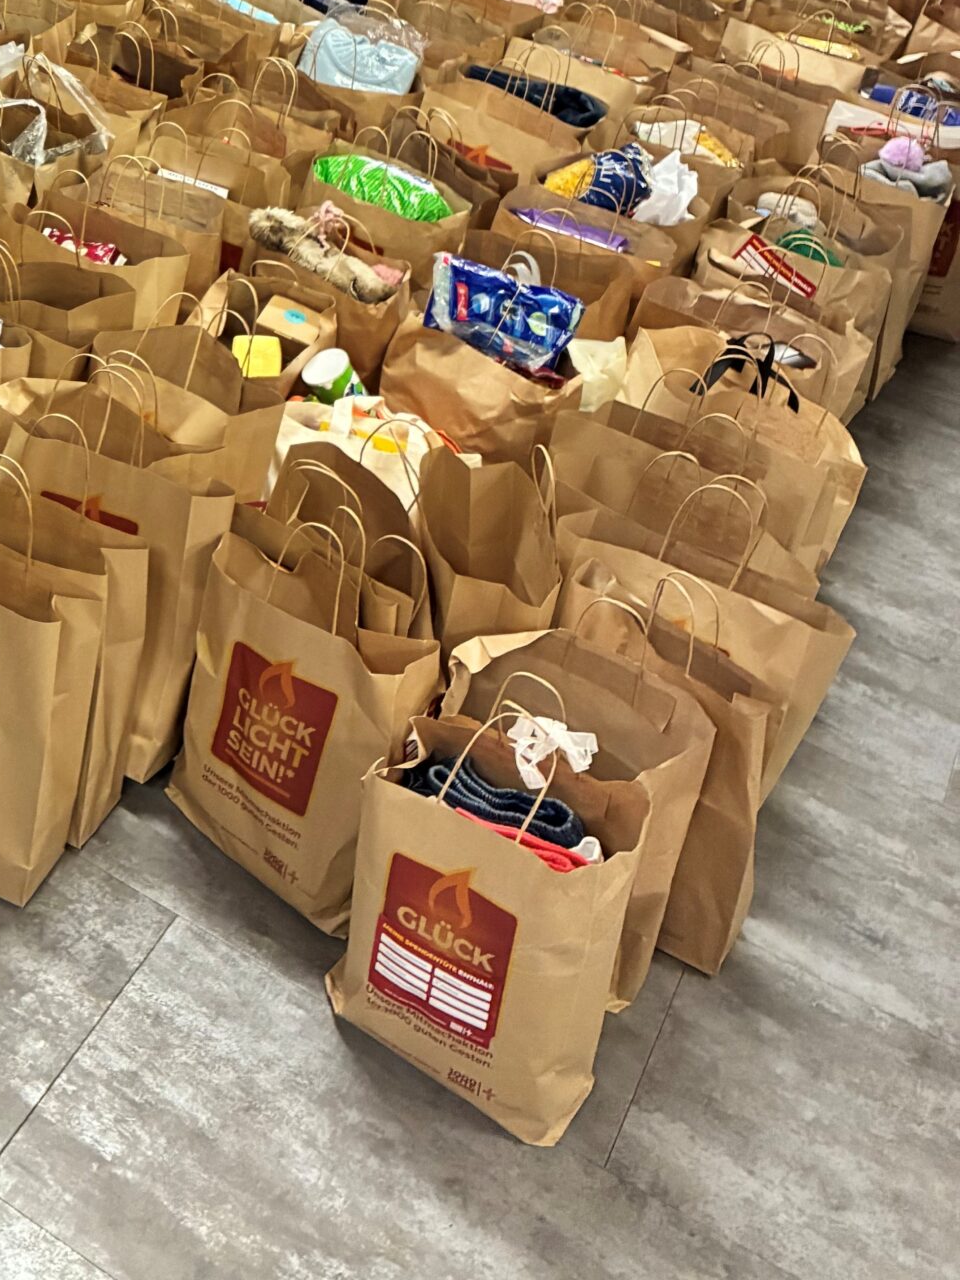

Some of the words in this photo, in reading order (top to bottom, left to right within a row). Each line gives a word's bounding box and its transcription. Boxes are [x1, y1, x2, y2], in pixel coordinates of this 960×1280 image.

[232, 705, 309, 768] LICHT
[239, 688, 316, 747] GLÜCK
[396, 906, 495, 973] GLÜCK
